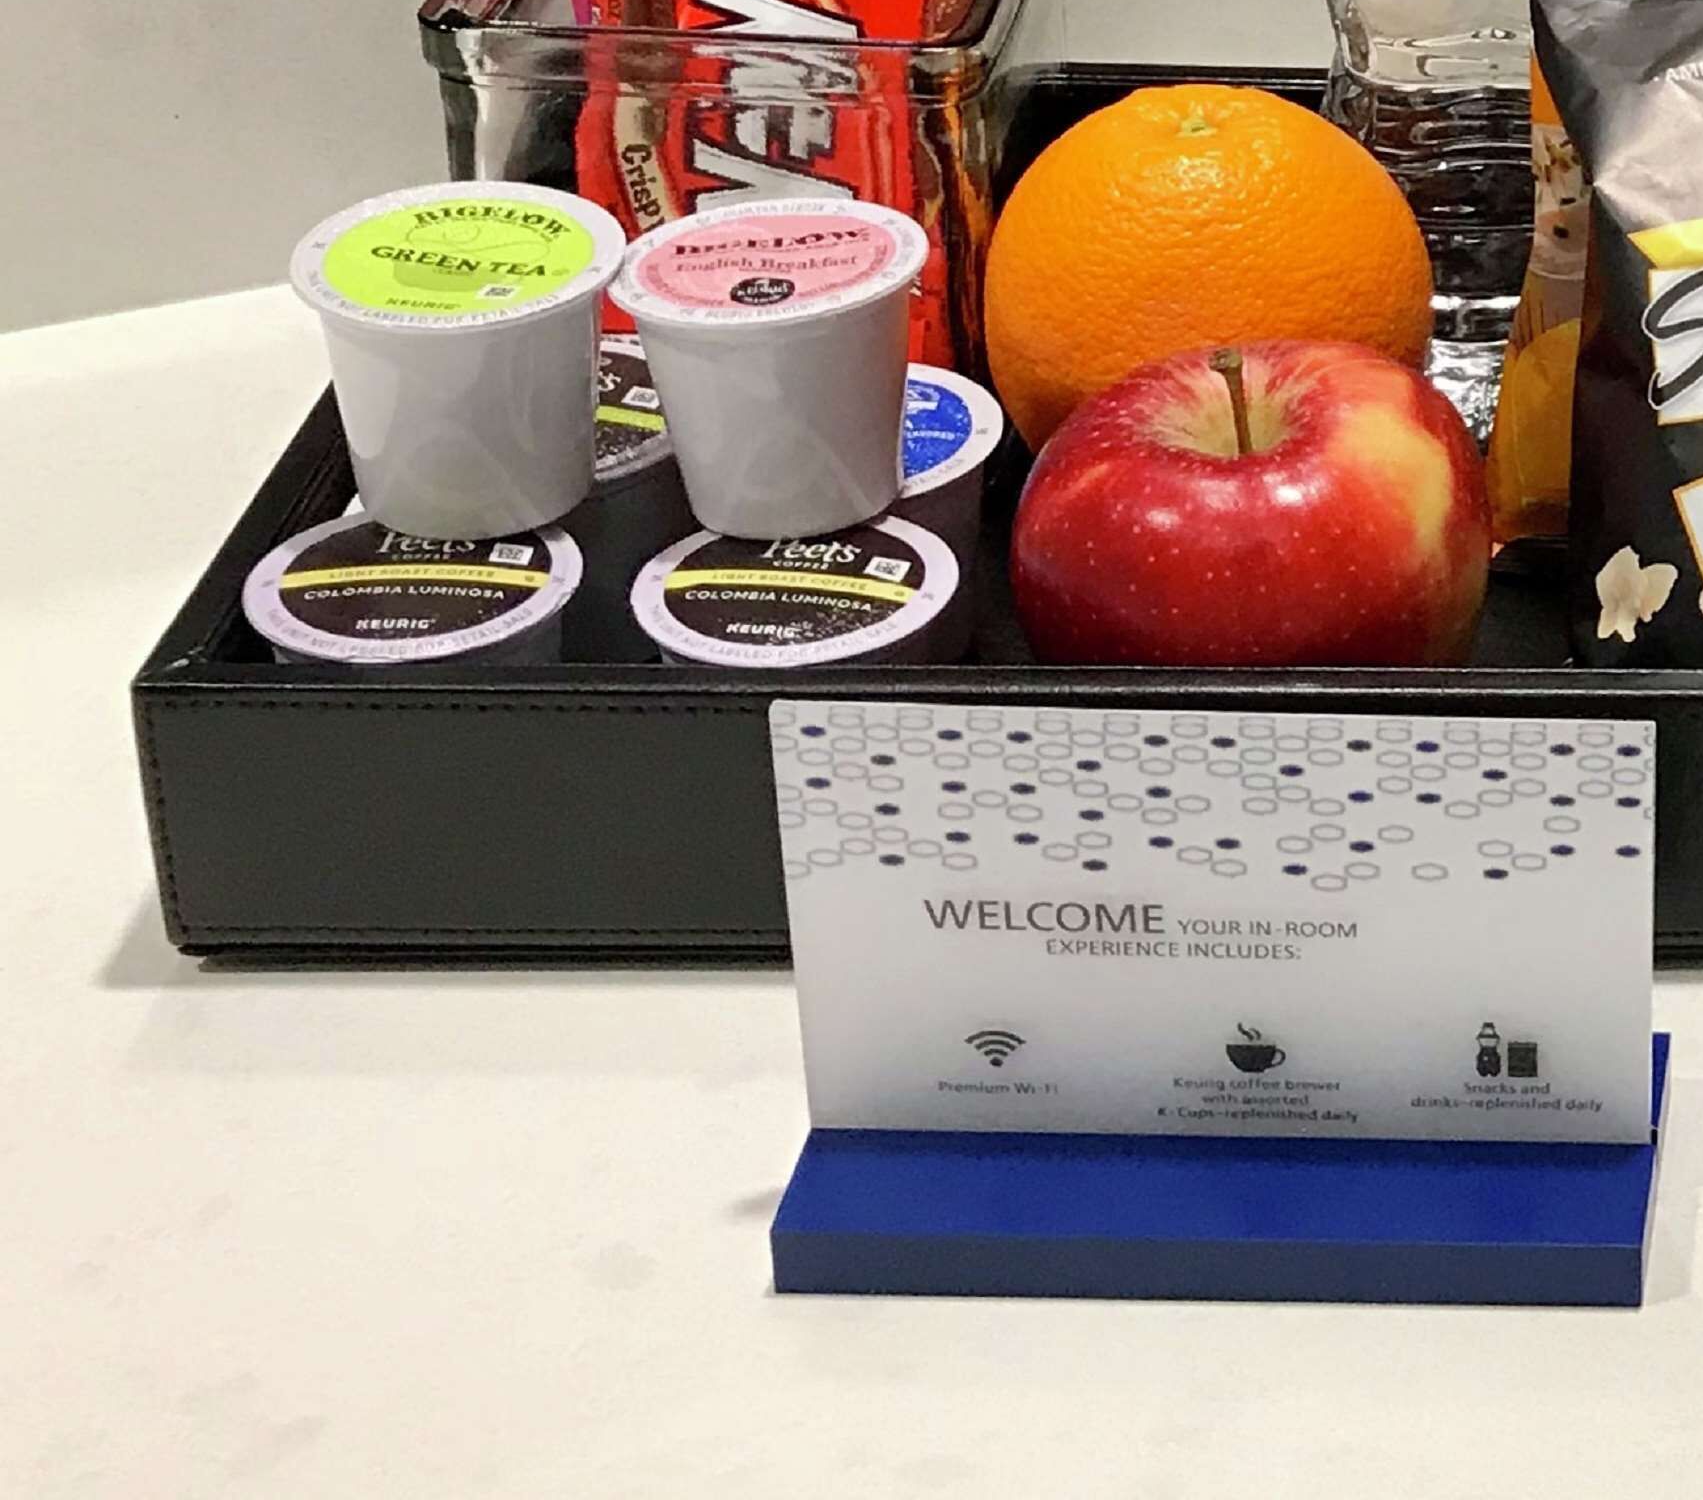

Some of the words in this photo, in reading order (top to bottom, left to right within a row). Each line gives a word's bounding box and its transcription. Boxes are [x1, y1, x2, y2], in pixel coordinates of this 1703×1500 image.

[621, 143, 661, 217] Crisp
[413, 204, 572, 238] BIGELOW
[370, 244, 482, 273] GREEN
[489, 261, 547, 276] TEA
[675, 255, 753, 273] English
[760, 254, 858, 272] Breakfast
[772, 559, 829, 570] COFFEE
[435, 567, 495, 579] COFFEE
[810, 576, 868, 591] COFFEE
[303, 584, 402, 600] COLOMBIA
[408, 585, 505, 600] LUMINOSA
[685, 589, 776, 602] COLOMBIA
[781, 591, 872, 613] LUMINOSA
[355, 616, 430, 631] KEURIG
[726, 621, 797, 638] KEURIG
[924, 899, 1166, 934] WELCOME
[1177, 918, 1241, 936] YOUR
[1249, 919, 1359, 938] IN-ROOM
[1046, 938, 1179, 958] EXPERIENCE
[1186, 941, 1302, 960] INCLUDES:
[937, 1080, 1010, 1095] Premium
[1173, 1076, 1226, 1092] Keurig
[1229, 1076, 1281, 1090] coffee
[1284, 1077, 1342, 1091] brewer
[1463, 1082, 1516, 1095] Snacks
[1520, 1082, 1551, 1095] and
[1202, 1092, 1239, 1104] with
[1242, 1092, 1309, 1106] assorted
[1564, 1097, 1603, 1113] daily
[1321, 1109, 1359, 1124] daily
